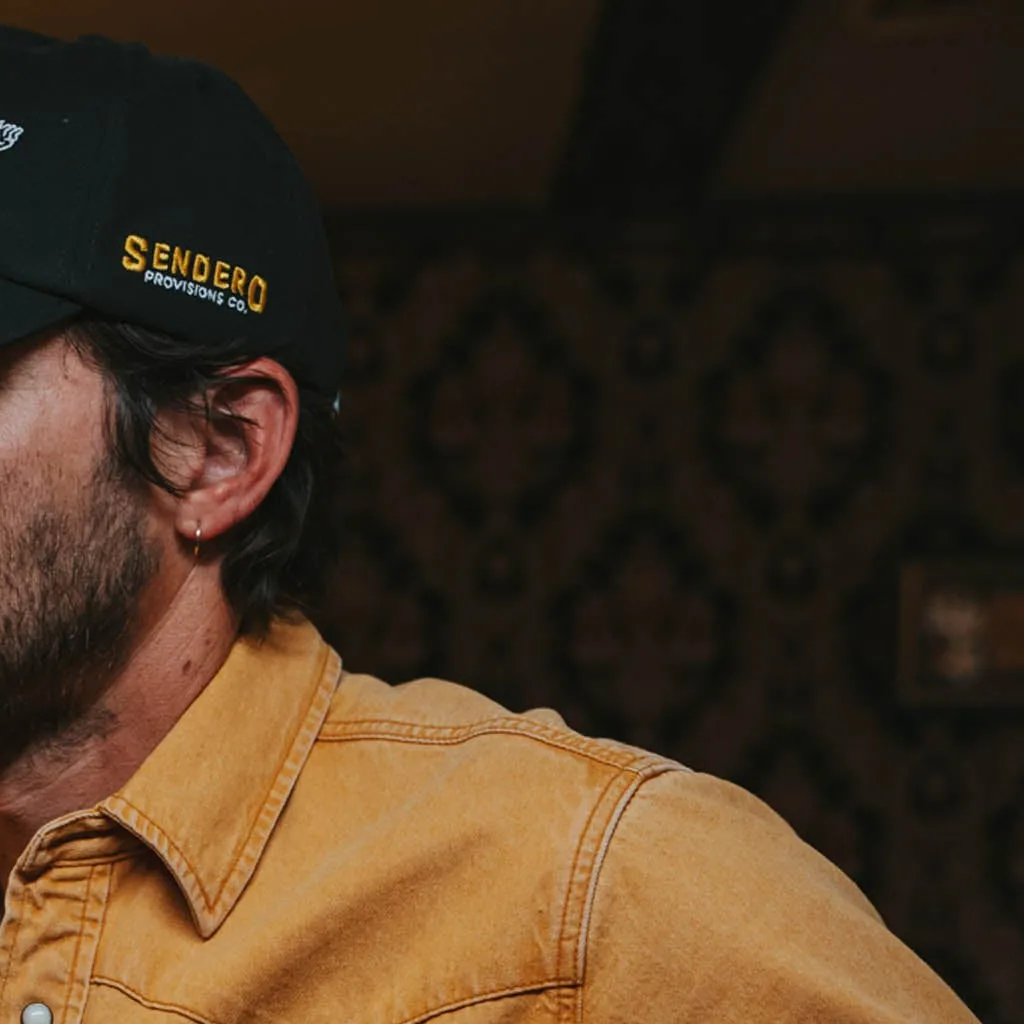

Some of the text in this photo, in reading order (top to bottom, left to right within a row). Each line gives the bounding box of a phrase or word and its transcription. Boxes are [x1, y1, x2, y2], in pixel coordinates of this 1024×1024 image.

[121, 233, 269, 314] SENDERO
[143, 269, 249, 315] PROVISIONS CO.
